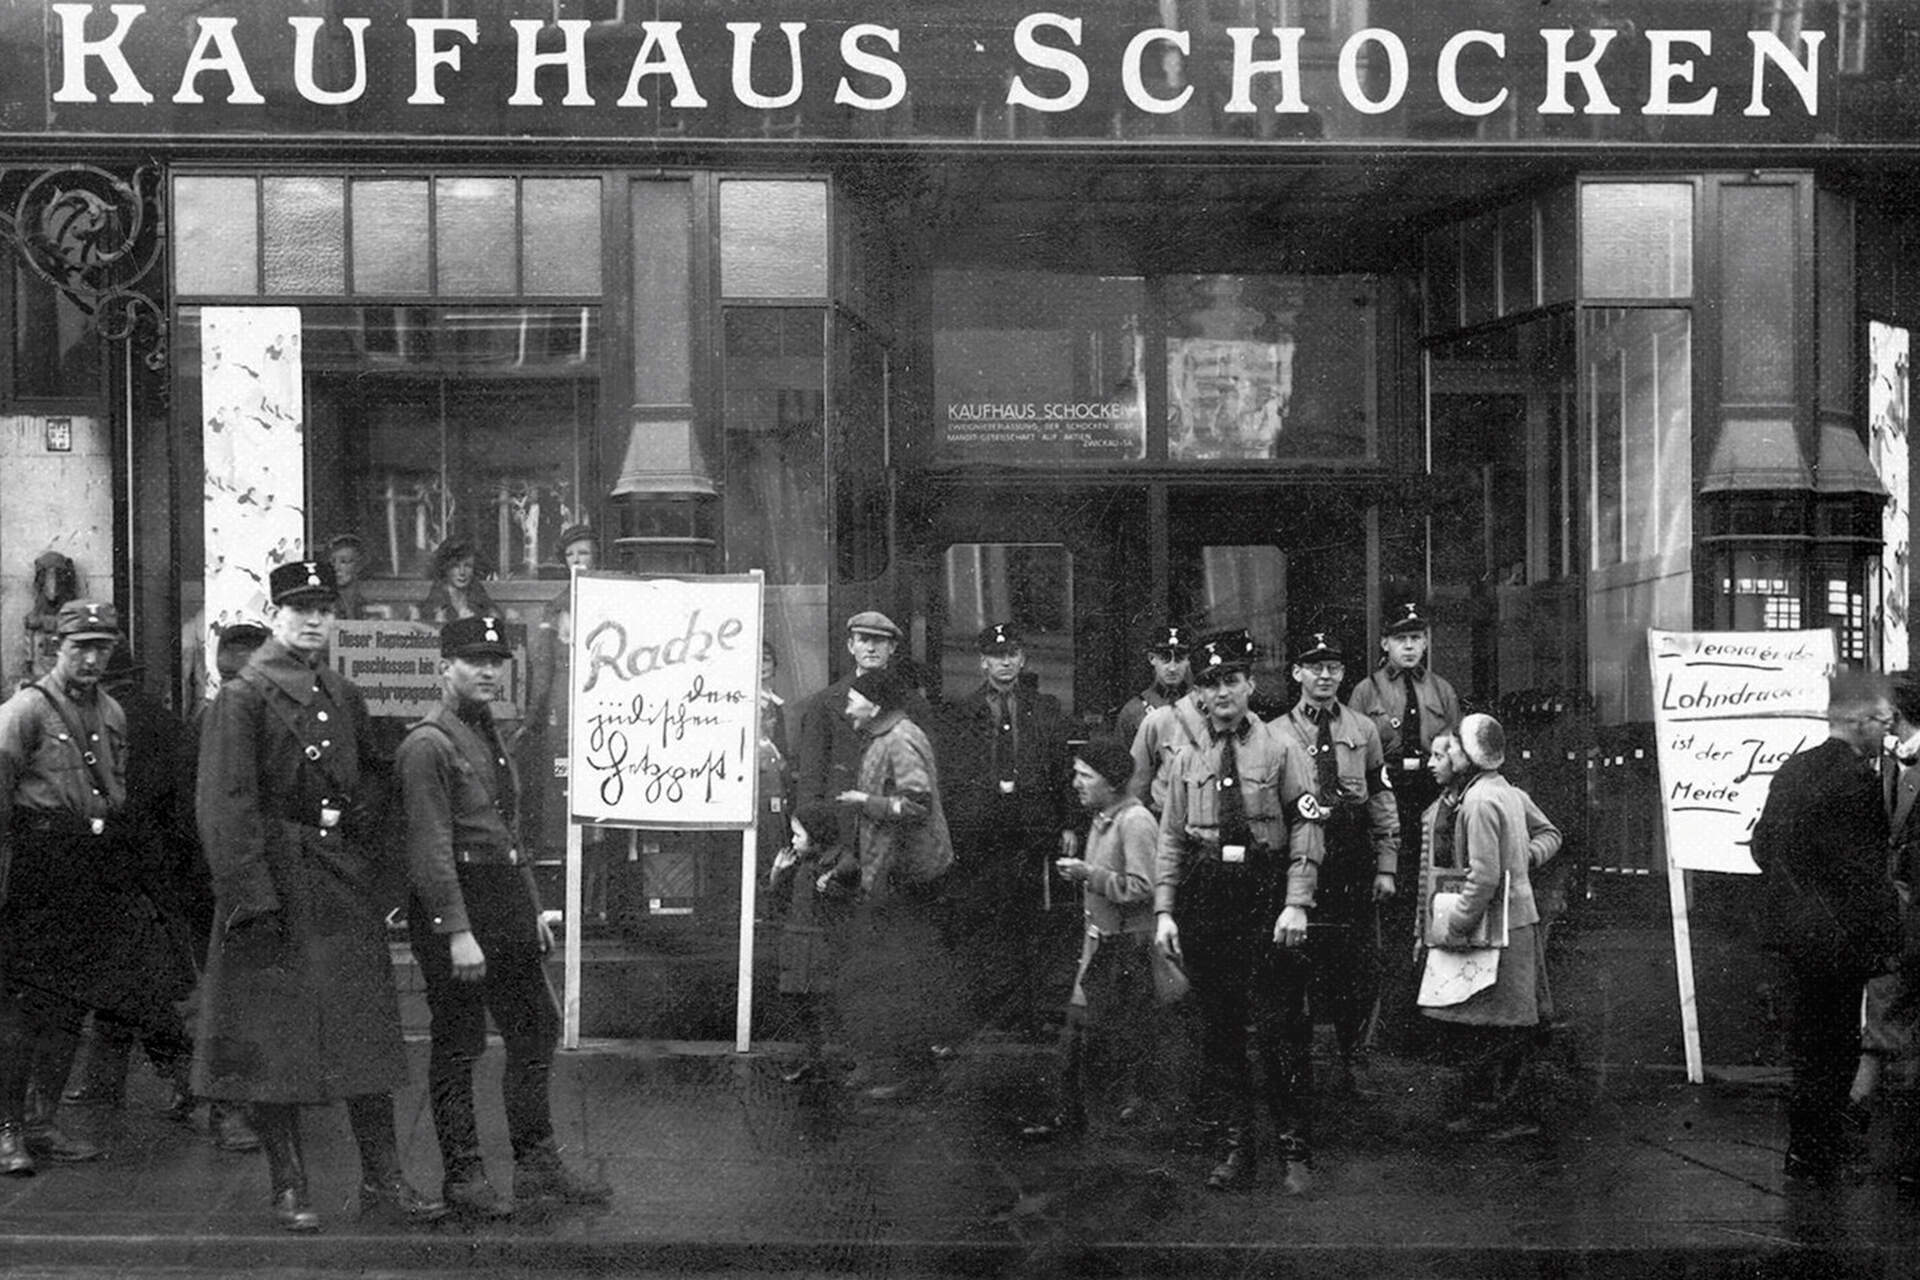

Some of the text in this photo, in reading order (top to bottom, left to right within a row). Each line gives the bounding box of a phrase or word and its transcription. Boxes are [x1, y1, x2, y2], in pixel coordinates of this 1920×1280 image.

[51, 3, 1827, 116] KAUFHAUS SCHOCKEN
[948, 403, 1036, 419] KAUFHAUS
[583, 608, 743, 693] Rache
[1671, 734, 1807, 784] ist der Jud
[1671, 781, 1740, 802] Meide
